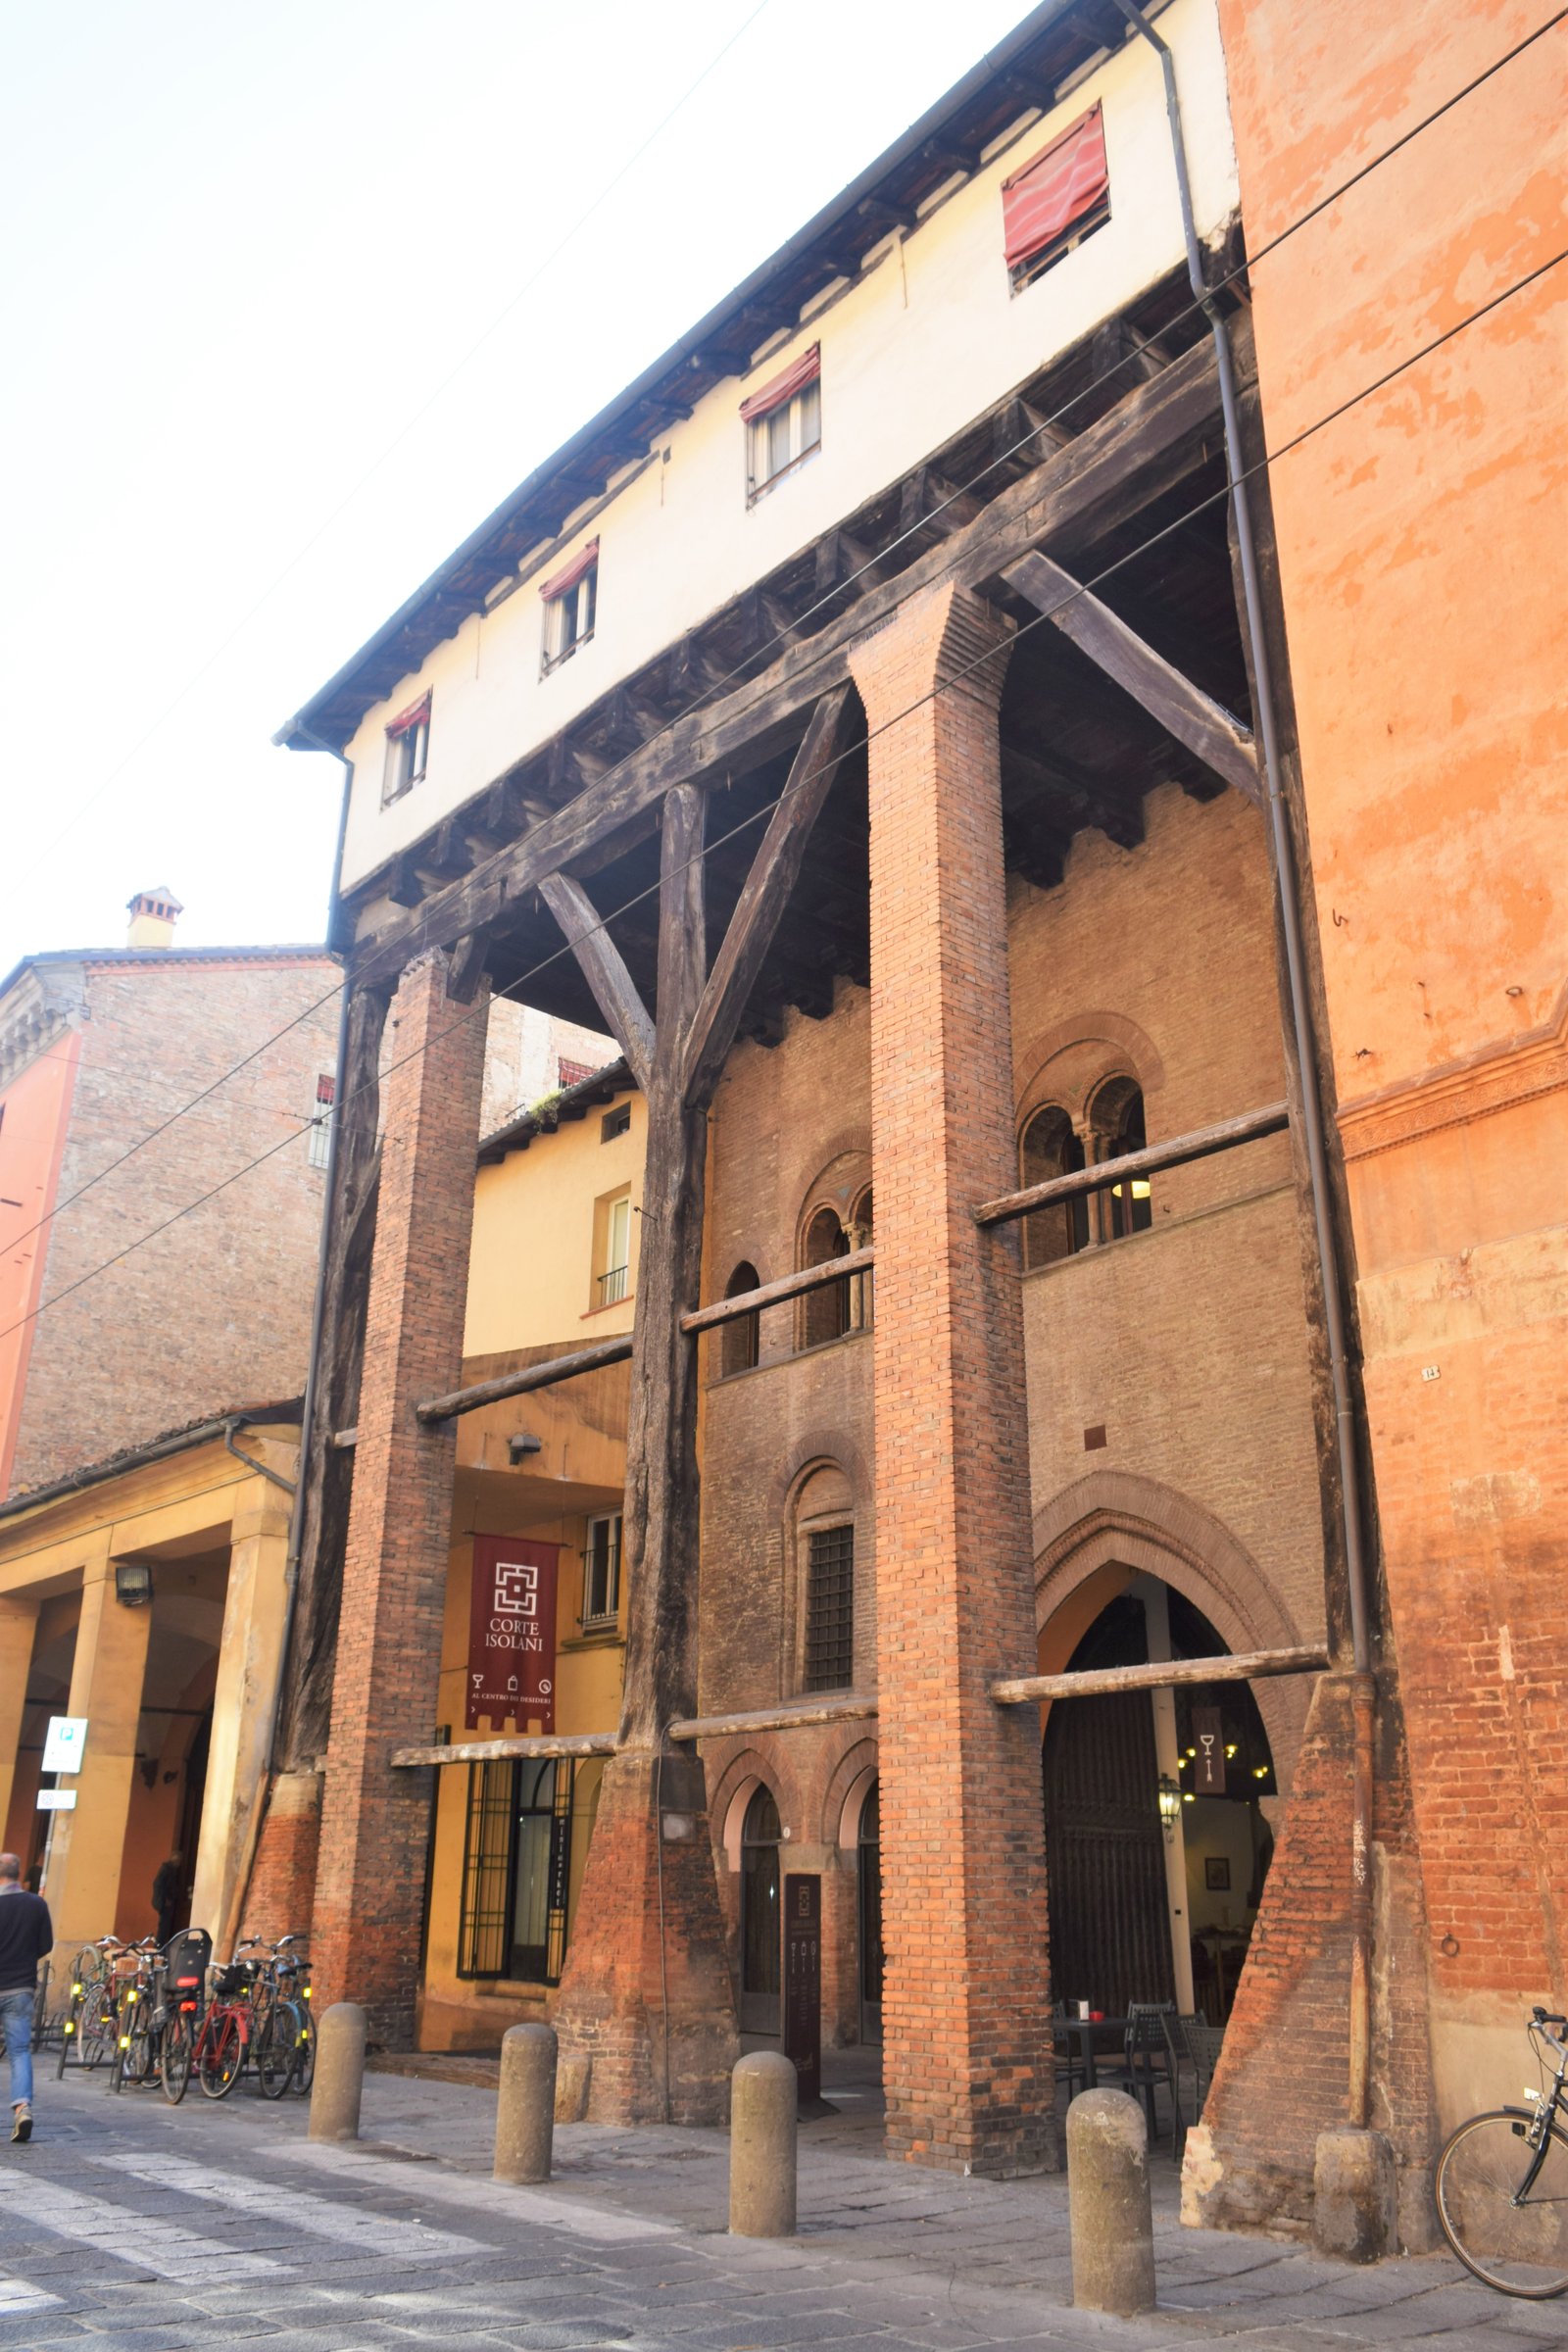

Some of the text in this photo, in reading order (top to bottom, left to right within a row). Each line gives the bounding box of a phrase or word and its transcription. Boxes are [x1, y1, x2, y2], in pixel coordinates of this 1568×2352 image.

[490, 1618, 540, 1636] CORTE
[485, 1633, 543, 1651] ISOLANI
[481, 1692, 509, 1701] CENTRO
[520, 1695, 551, 1704] DESIDERI
